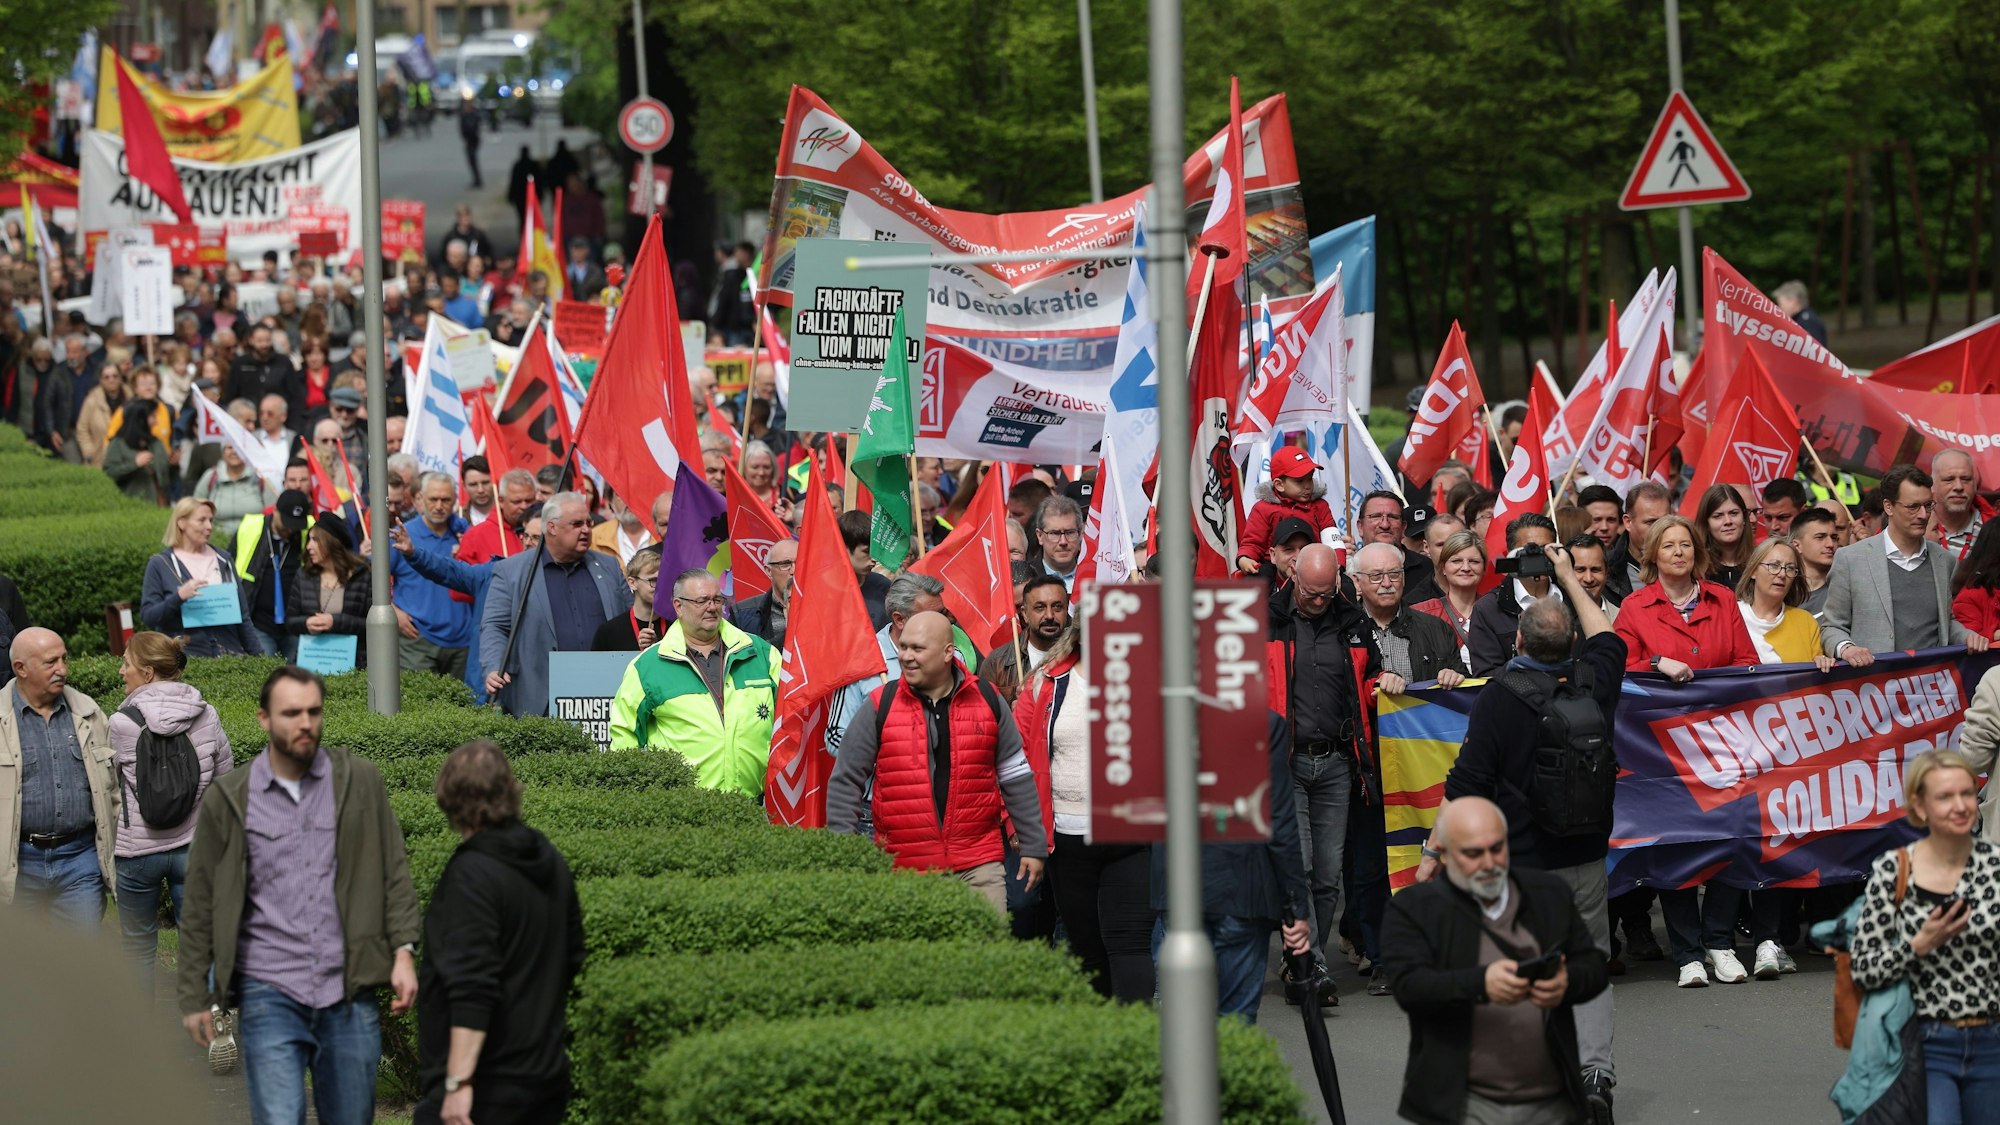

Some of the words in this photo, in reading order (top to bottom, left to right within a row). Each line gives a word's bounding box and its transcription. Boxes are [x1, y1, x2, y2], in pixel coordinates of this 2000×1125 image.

[635, 116, 658, 138] 50
[881, 173, 912, 197] SPD
[817, 288, 902, 314] FACHKRÄFTE
[956, 287, 1099, 316] Demokratie
[799, 312, 849, 335] FALLEN
[853, 314, 896, 337] NICHT
[821, 336, 852, 358] VOM
[857, 337, 918, 361] HIML!
[953, 336, 1105, 362] UNDHEIT
[989, 407, 1018, 419] SICHER
[1020, 412, 1039, 423] UND
[988, 424, 1006, 434] Gute
[1104, 589, 1141, 622] &
[1214, 588, 1260, 710] Mehr
[557, 698, 614, 720] TRANSF
[1104, 633, 1142, 786] bessere
[1666, 668, 1961, 790] UNGEBROCHEN
[1767, 722, 1963, 848] SOLIDA
